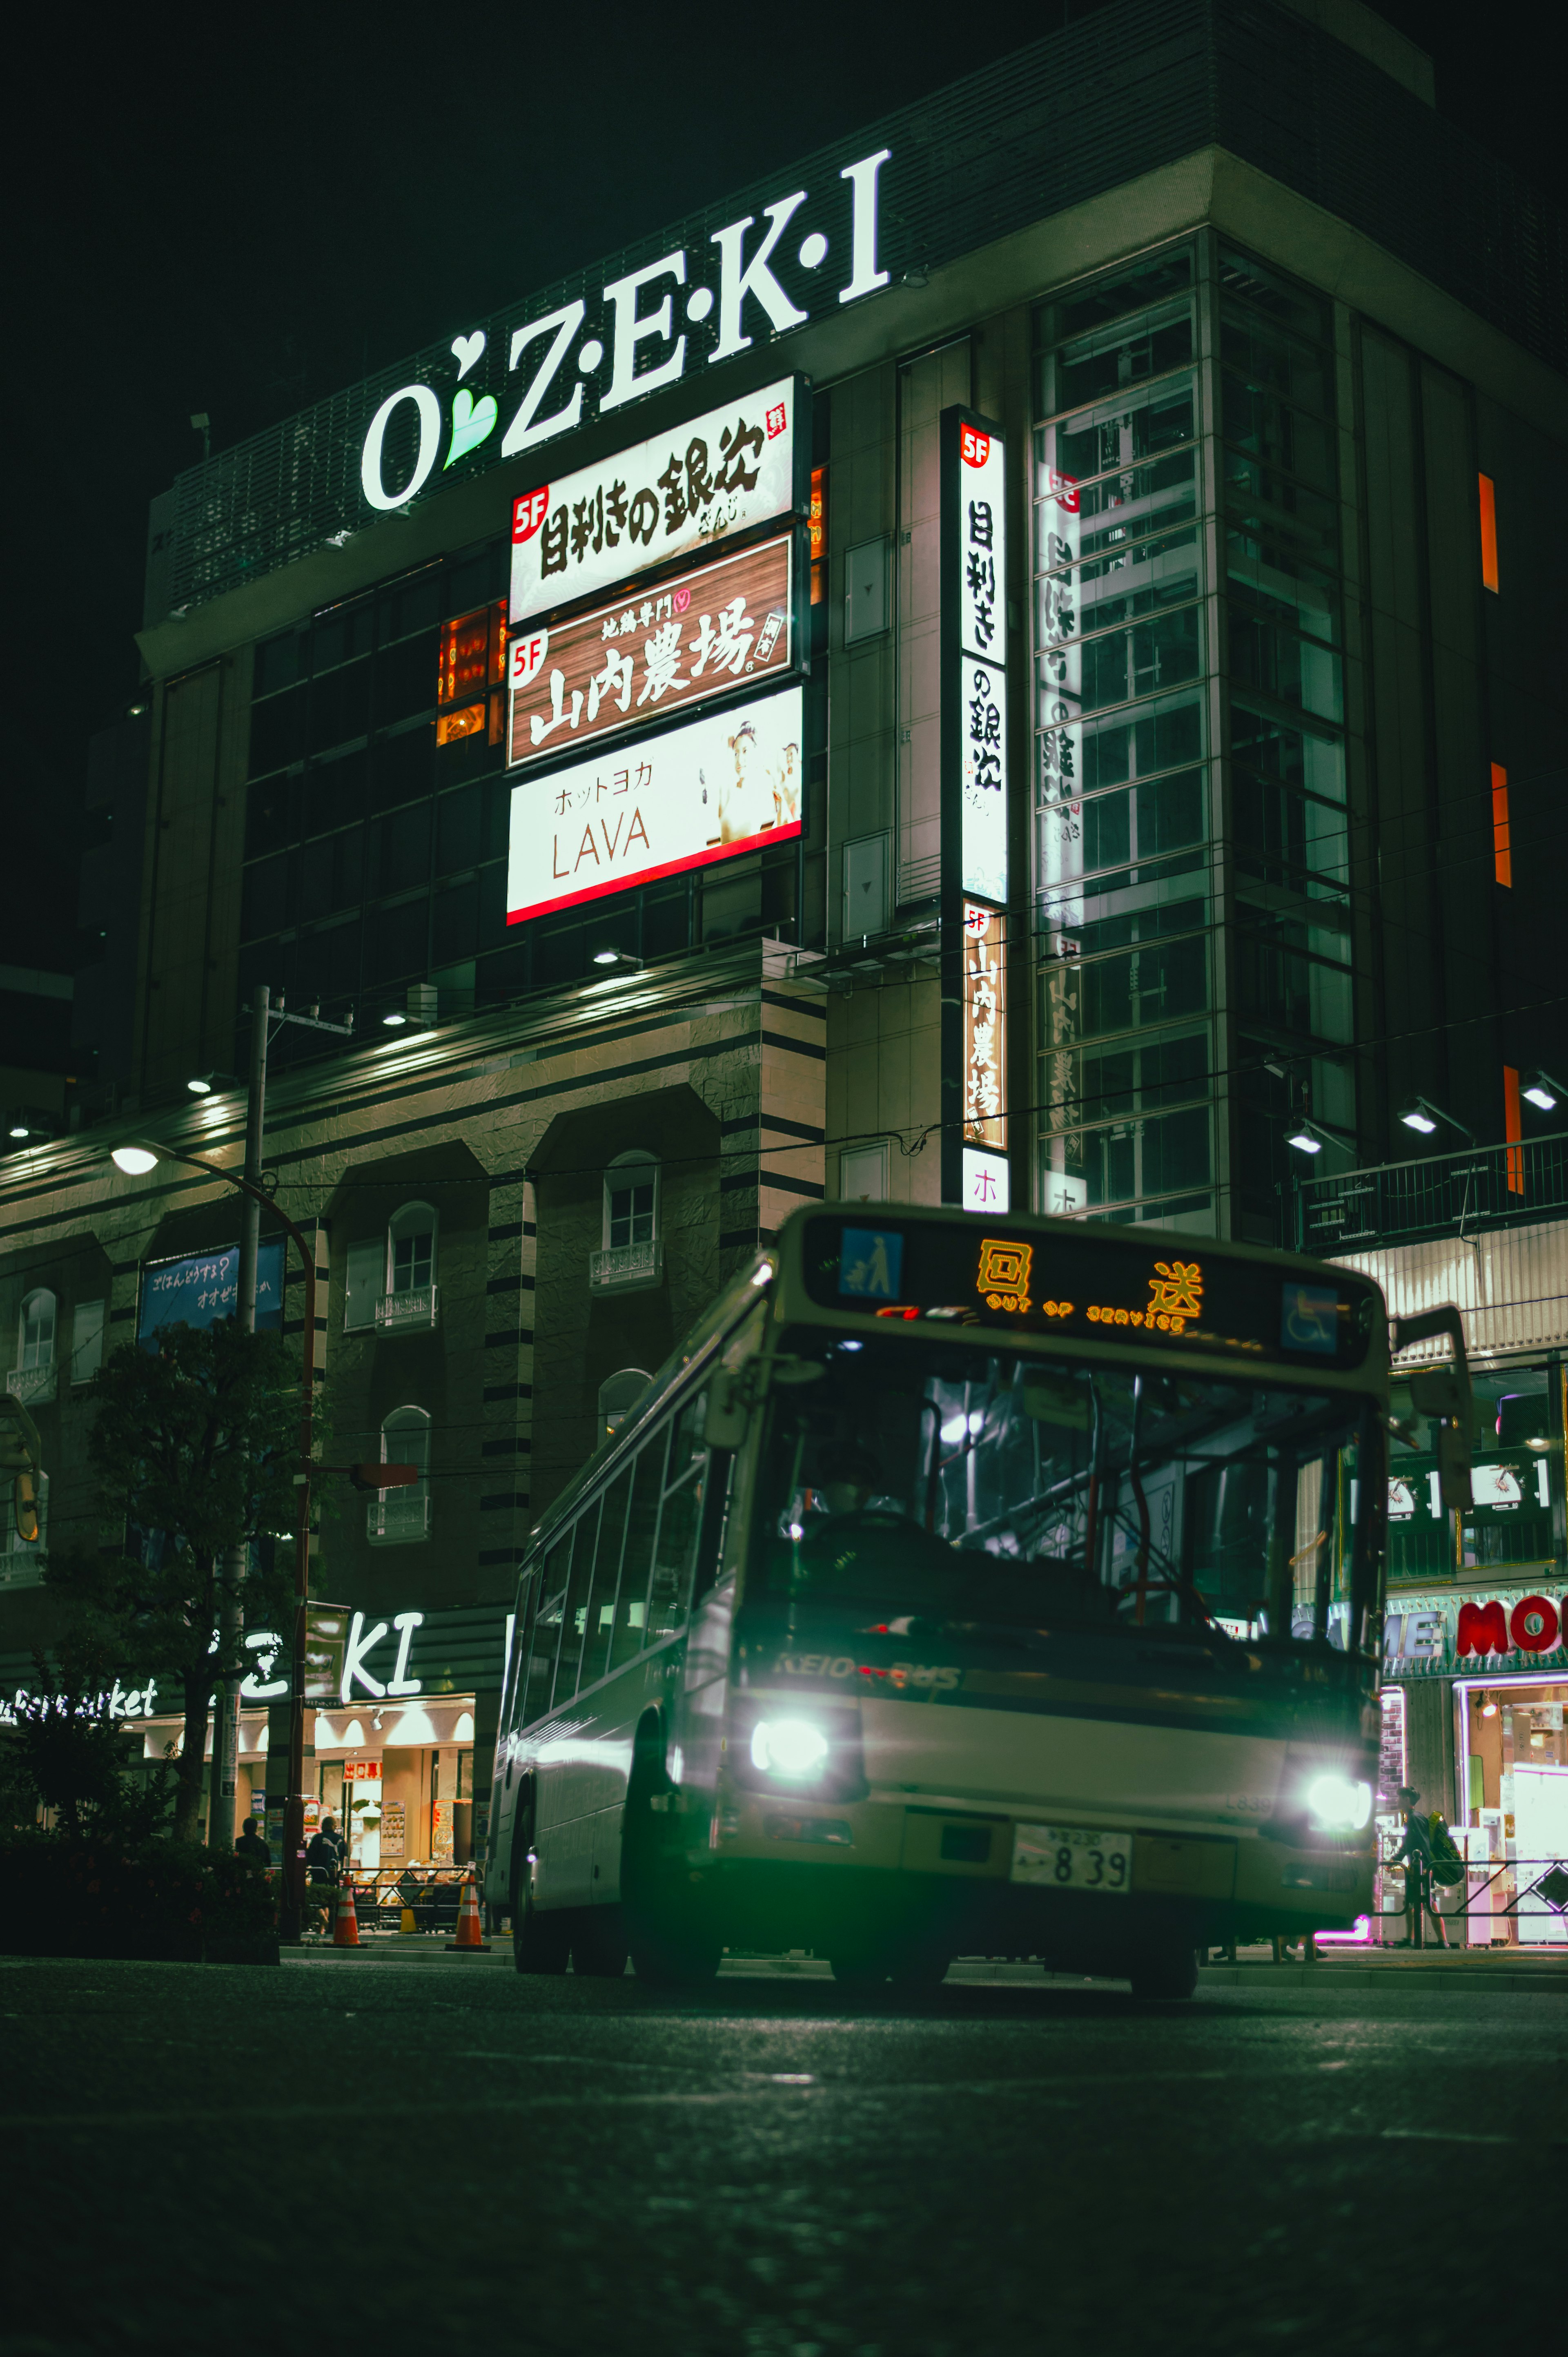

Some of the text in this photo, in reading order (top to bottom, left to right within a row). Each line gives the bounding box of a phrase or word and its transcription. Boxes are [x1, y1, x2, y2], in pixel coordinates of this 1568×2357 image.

[964, 434, 987, 463] 5F
[514, 495, 546, 535] 5F
[541, 417, 765, 580] 目利きの銀次
[513, 638, 541, 677] 5F
[530, 597, 755, 746] 山内農場
[555, 756, 654, 815] ホットヨガ
[553, 807, 650, 879] LAVA
[968, 910, 985, 931] 5F
[968, 939, 1000, 1122] 山内農場
[986, 1293, 1185, 1331] OUT OF SERVICE
[1456, 1594, 1568, 1658] MO
[774, 1652, 962, 1690] KEIO BUS
